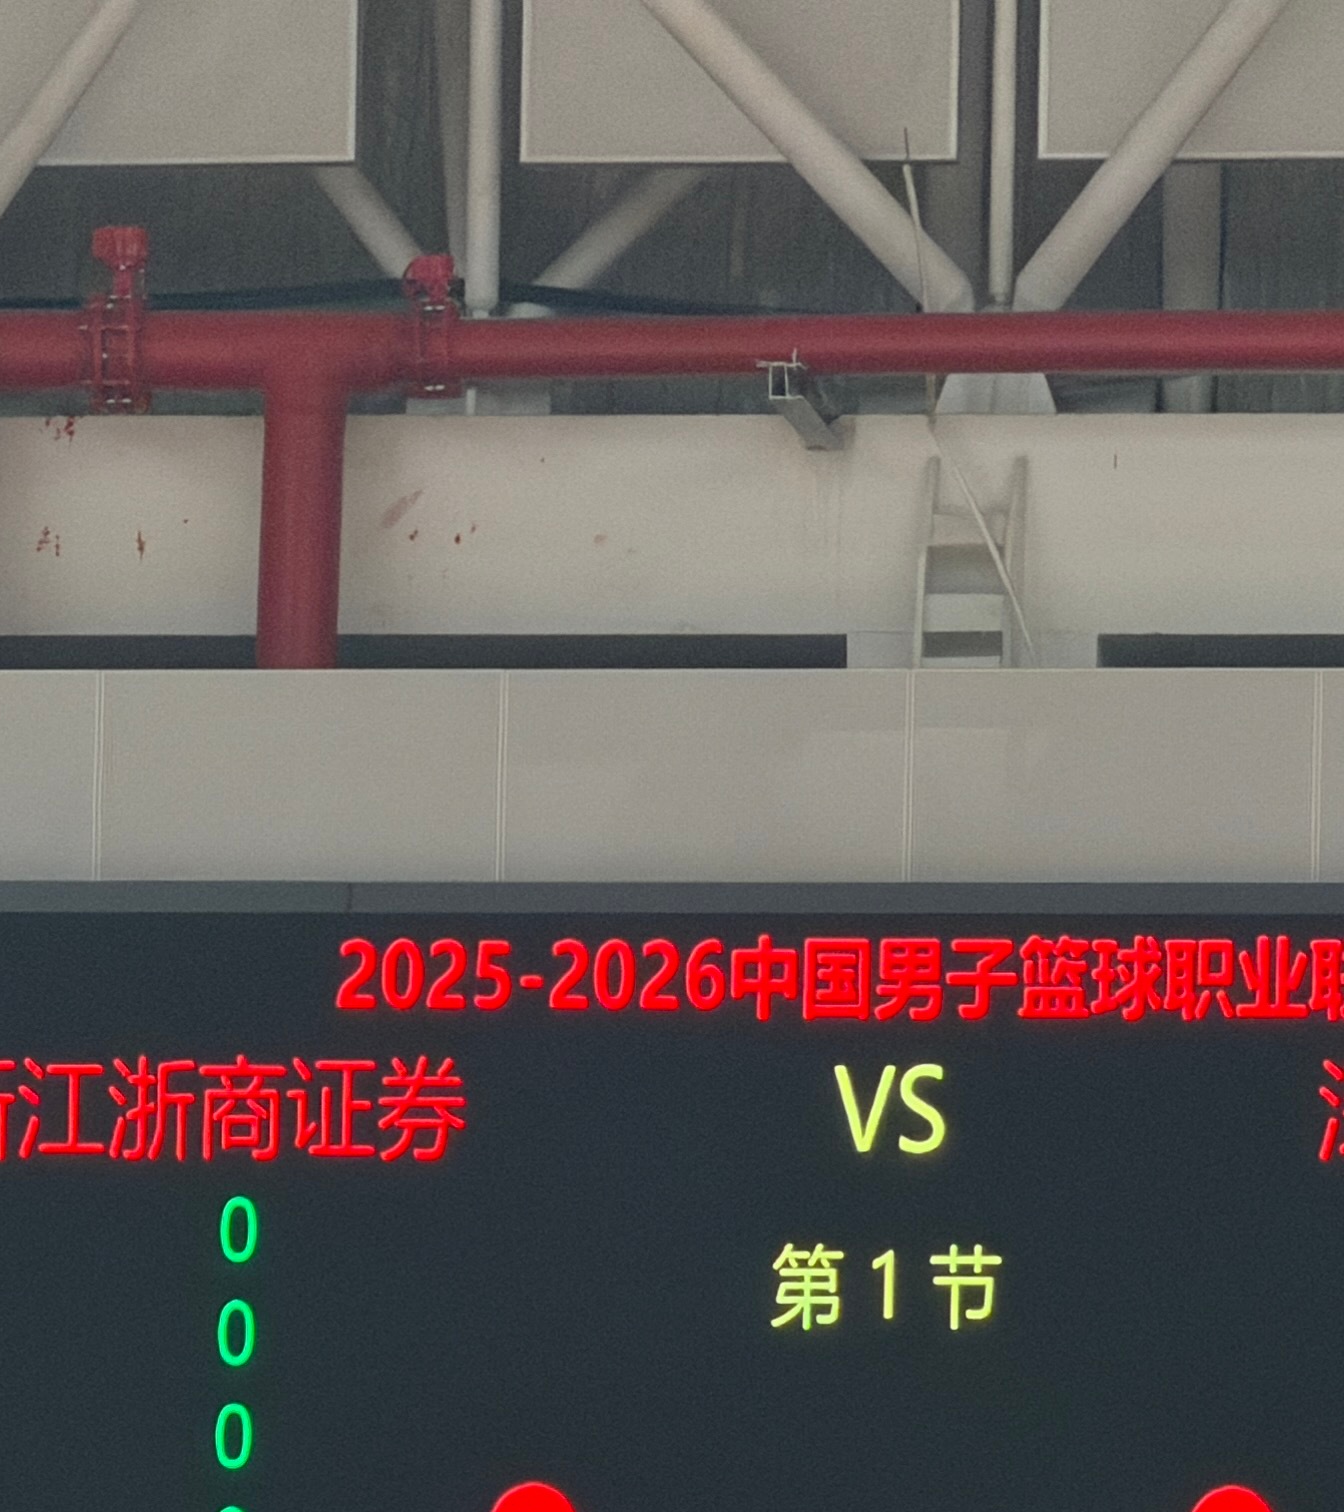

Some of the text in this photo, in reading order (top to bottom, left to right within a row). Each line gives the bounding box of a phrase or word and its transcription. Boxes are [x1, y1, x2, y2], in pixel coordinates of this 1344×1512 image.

[834, 1064, 946, 1154] VS
[220, 1196, 257, 1263] 0
[218, 1299, 255, 1366] 0
[215, 1403, 252, 1469] 0
